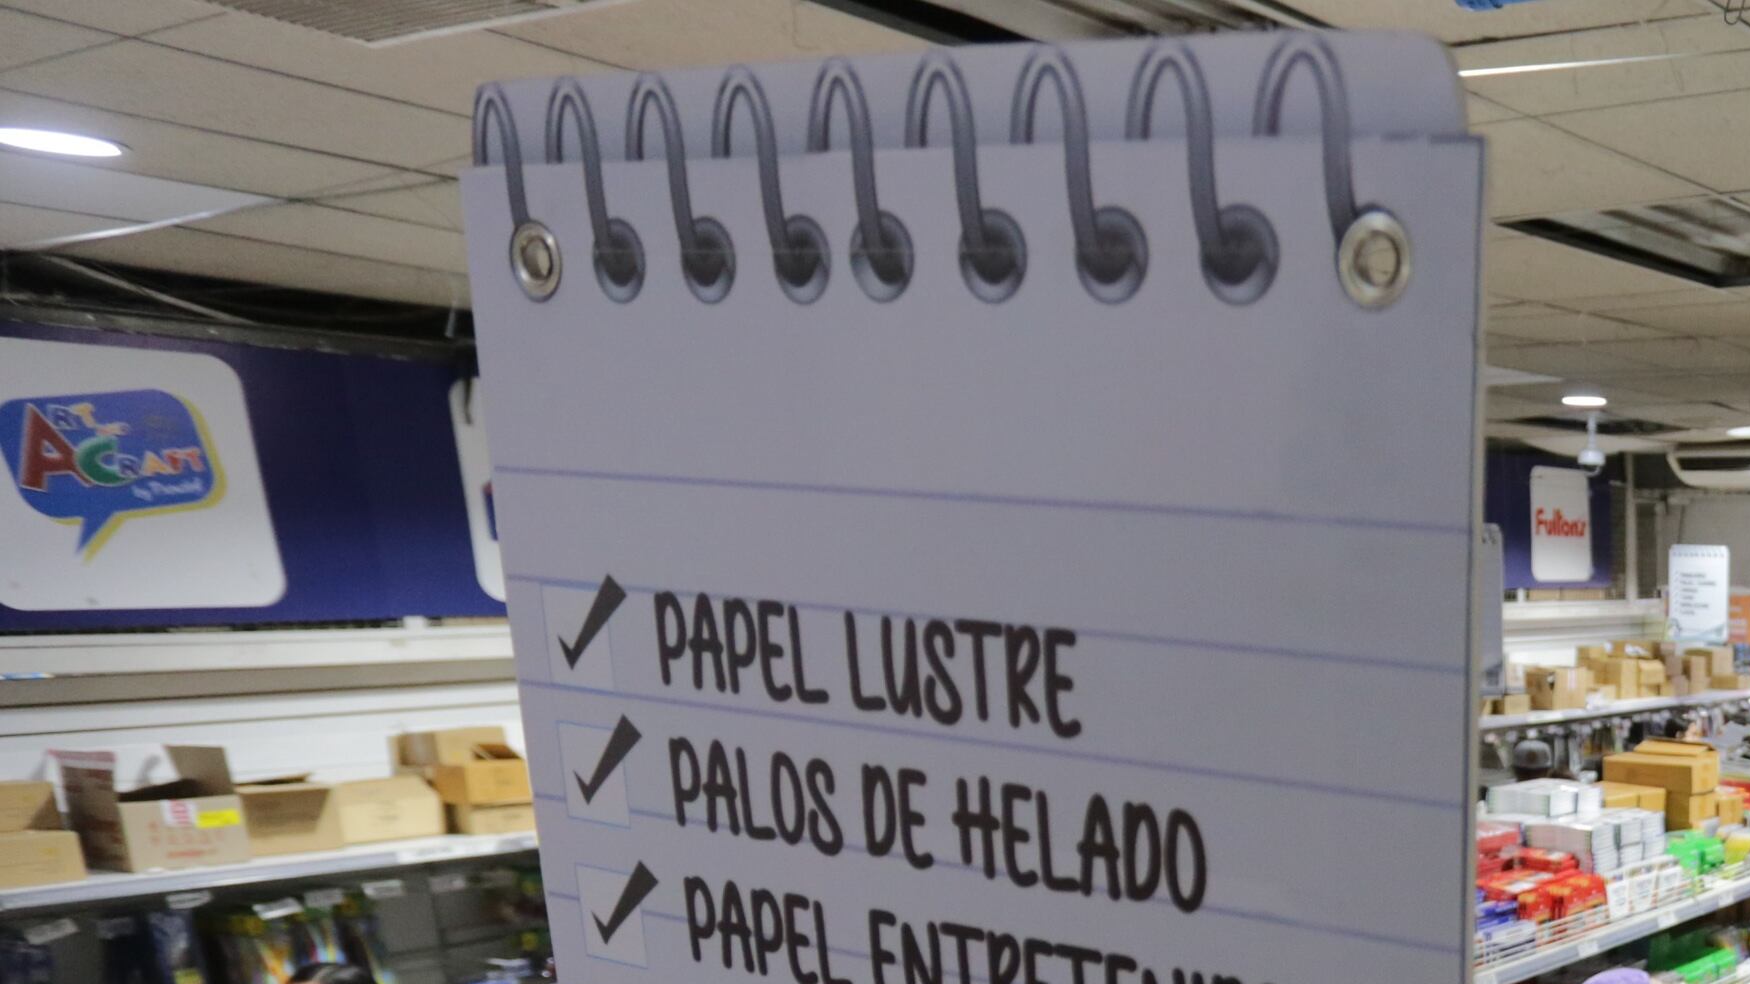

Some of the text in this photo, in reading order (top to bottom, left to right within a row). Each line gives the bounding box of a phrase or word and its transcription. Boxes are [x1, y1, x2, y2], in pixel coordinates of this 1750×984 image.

[654, 591, 1082, 738] PAPEL LUSTRE
[668, 737, 1206, 913] PALOS DE HELADO
